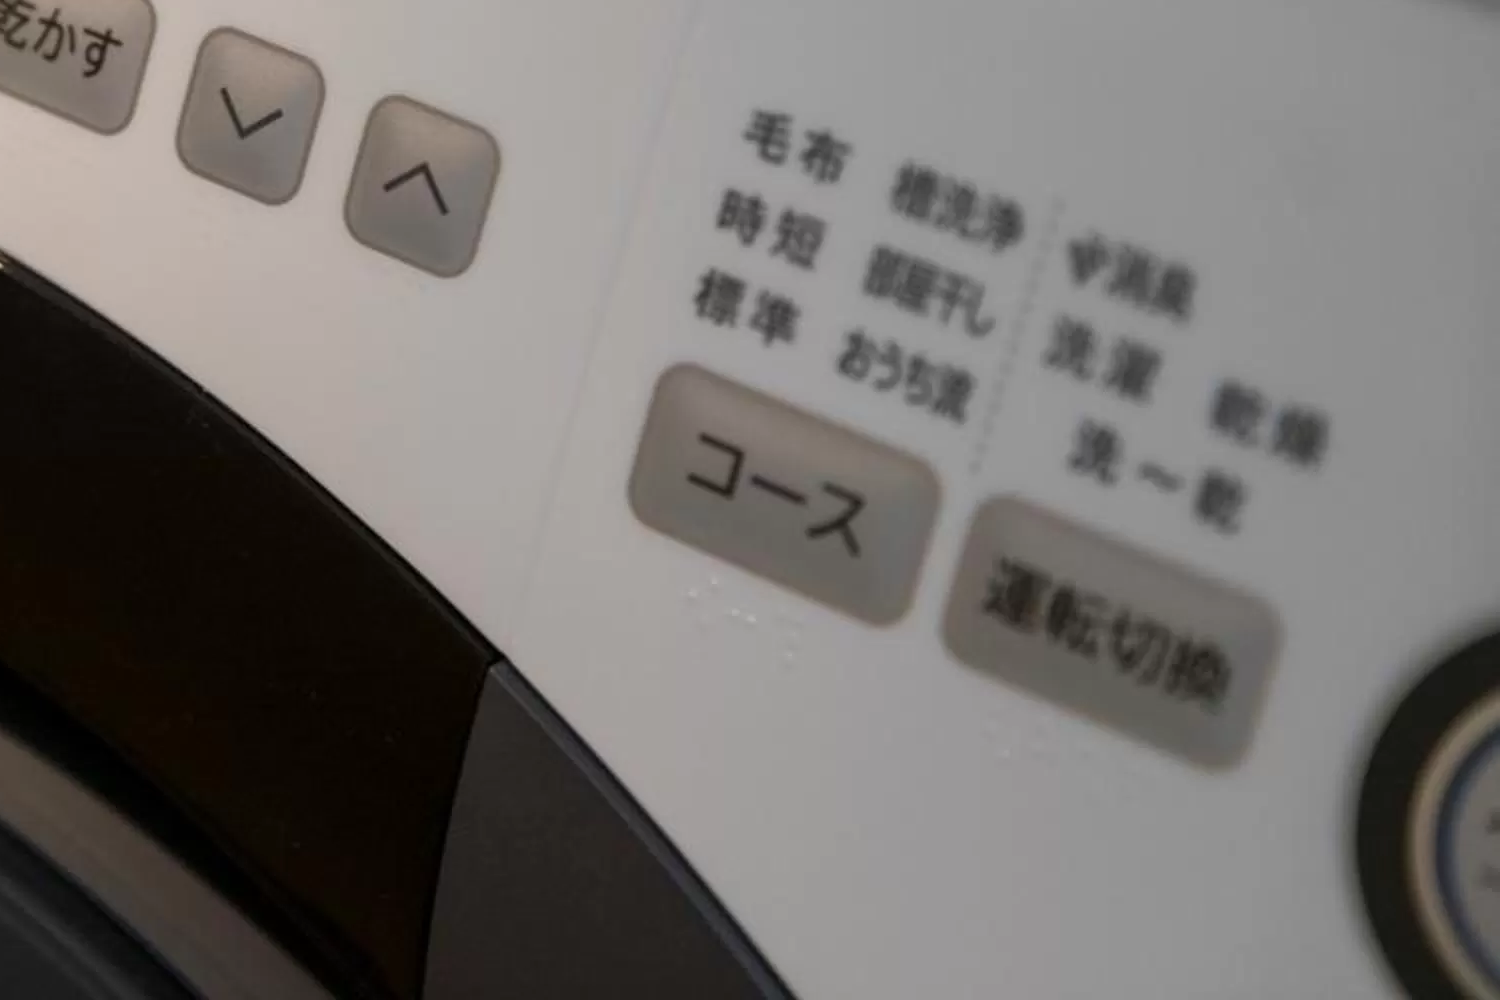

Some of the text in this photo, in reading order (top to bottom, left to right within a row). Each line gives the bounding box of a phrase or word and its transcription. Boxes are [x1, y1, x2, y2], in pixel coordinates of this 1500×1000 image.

[743, 108, 853, 185] 毛布
[715, 187, 829, 271] 時短
[693, 266, 803, 346] 標準
[686, 430, 867, 560] コース
[982, 553, 1234, 714] 運転切換
